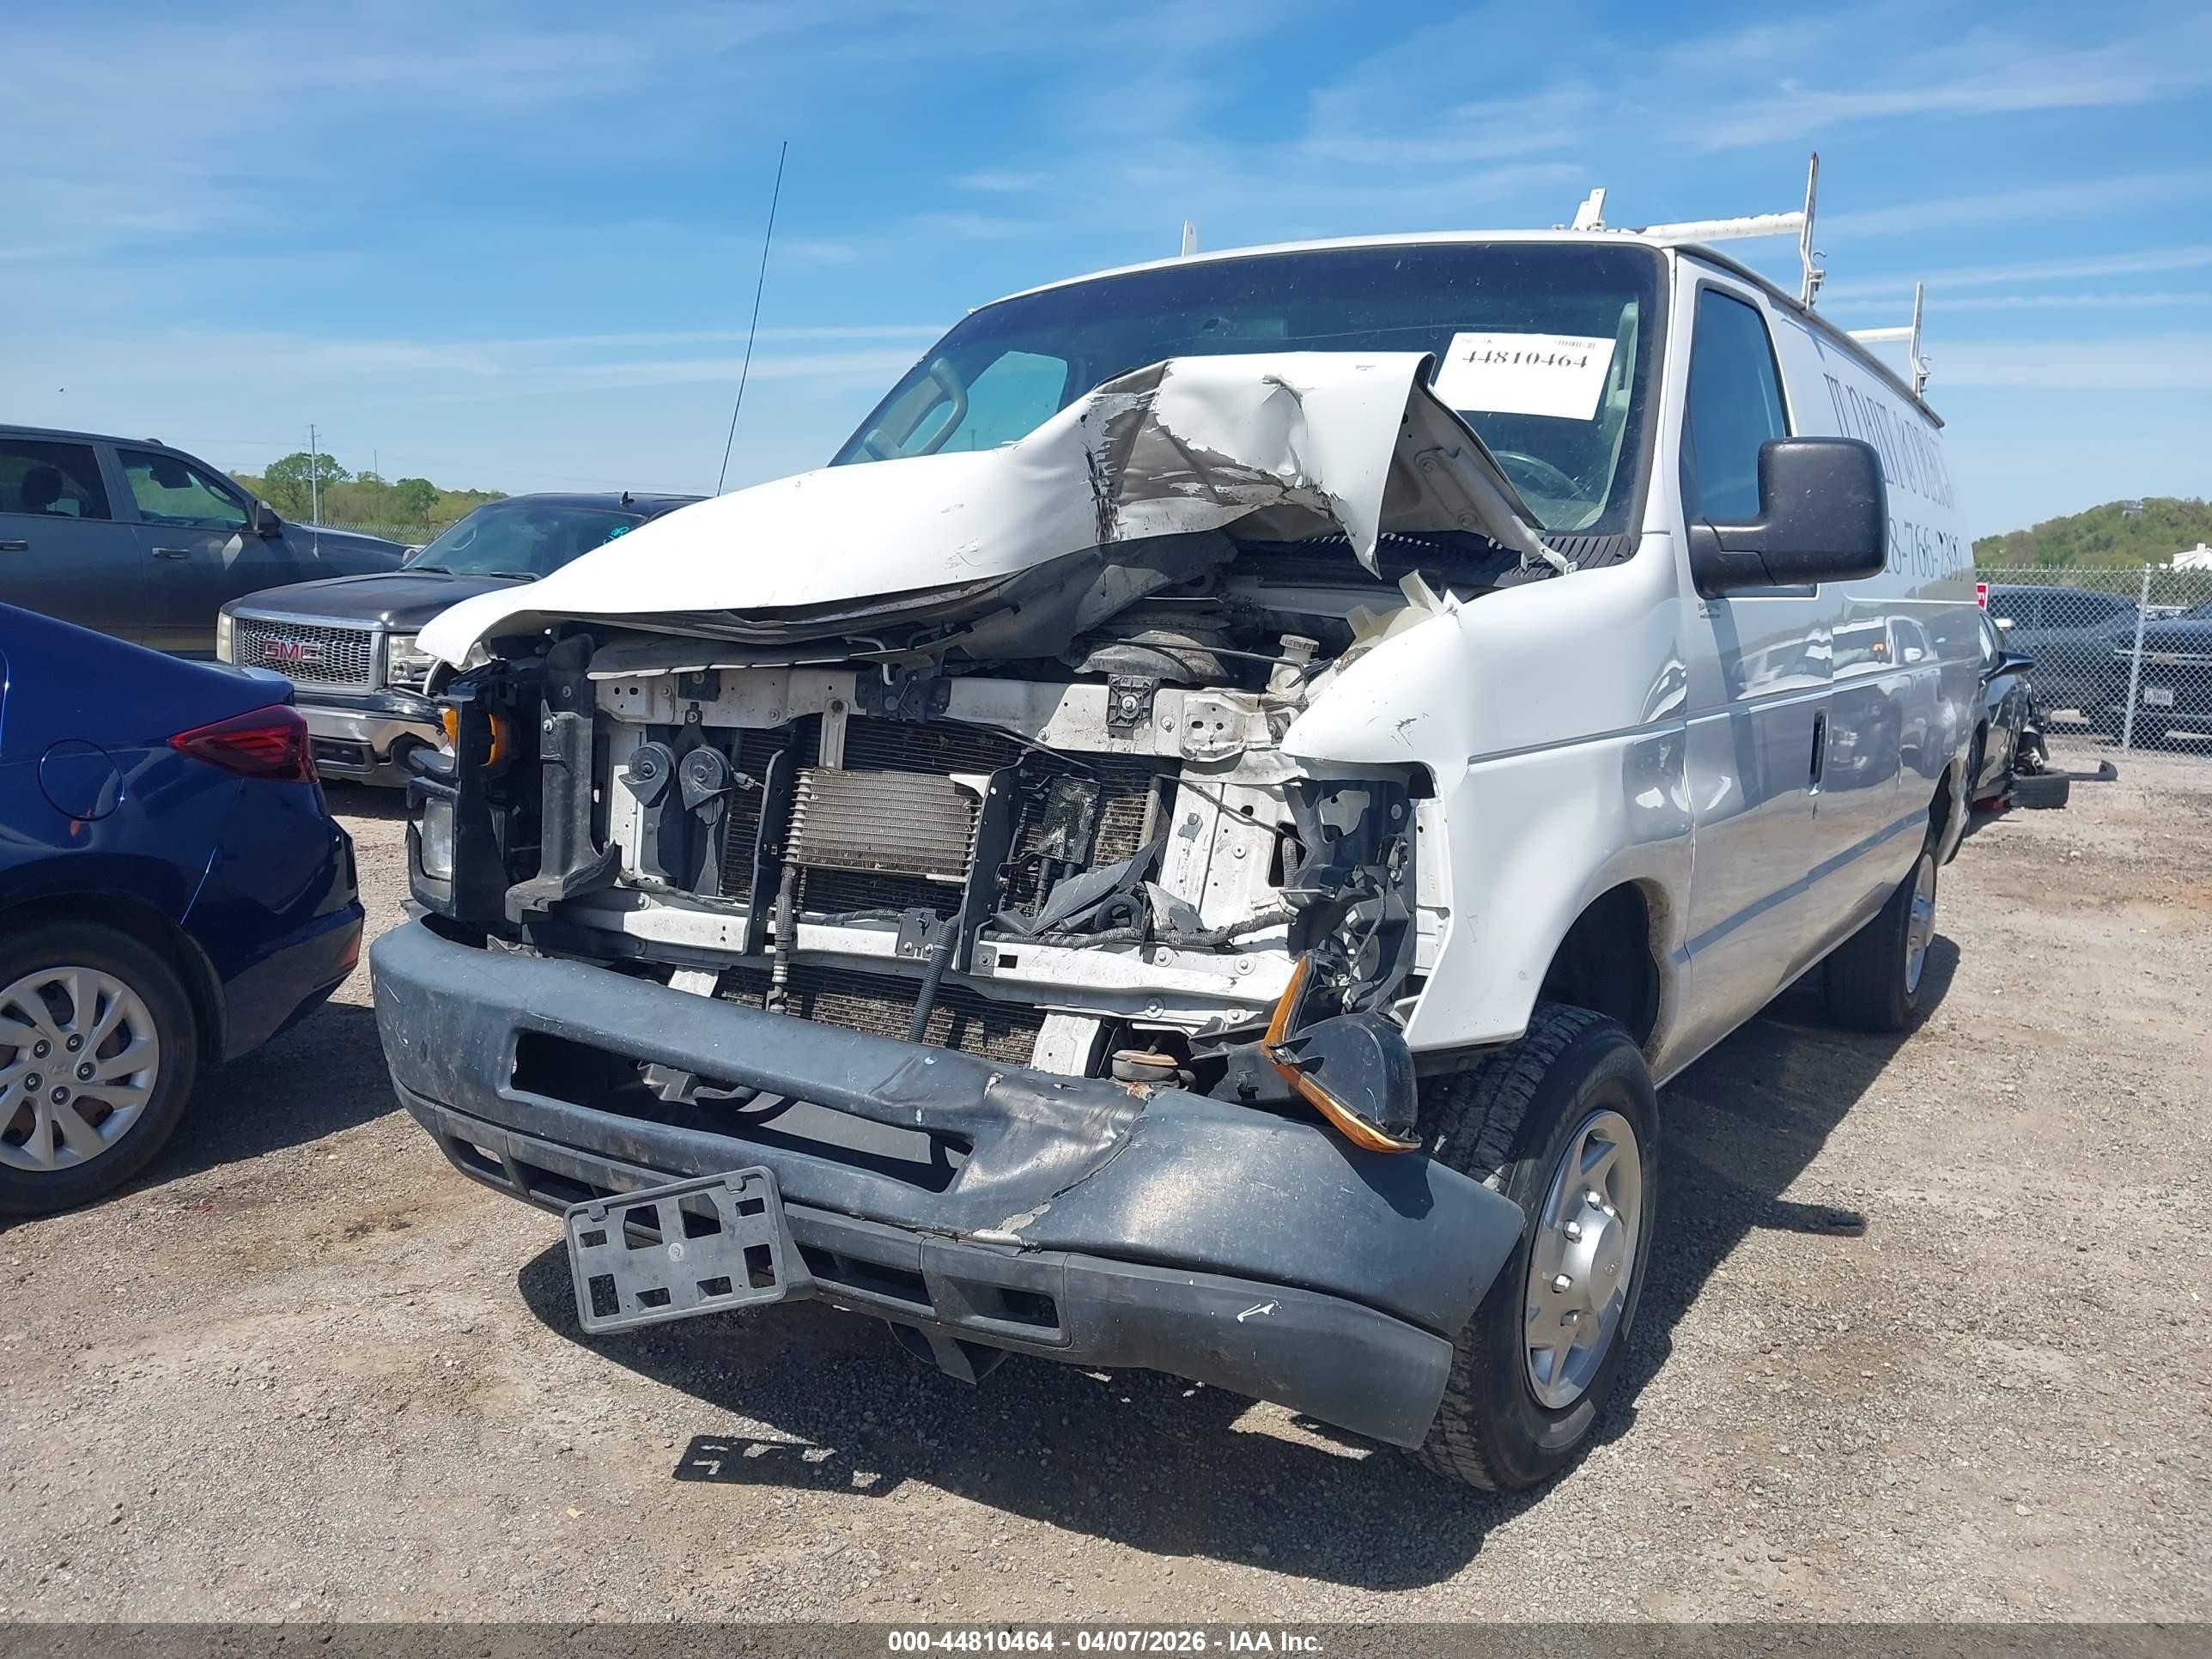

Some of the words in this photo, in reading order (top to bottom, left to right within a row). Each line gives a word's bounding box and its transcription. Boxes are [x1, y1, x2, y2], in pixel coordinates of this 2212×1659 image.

[1462, 349, 1588, 368] 44810464
[1884, 516, 1964, 582] 8-766-2399
[263, 640, 321, 661] GMC
